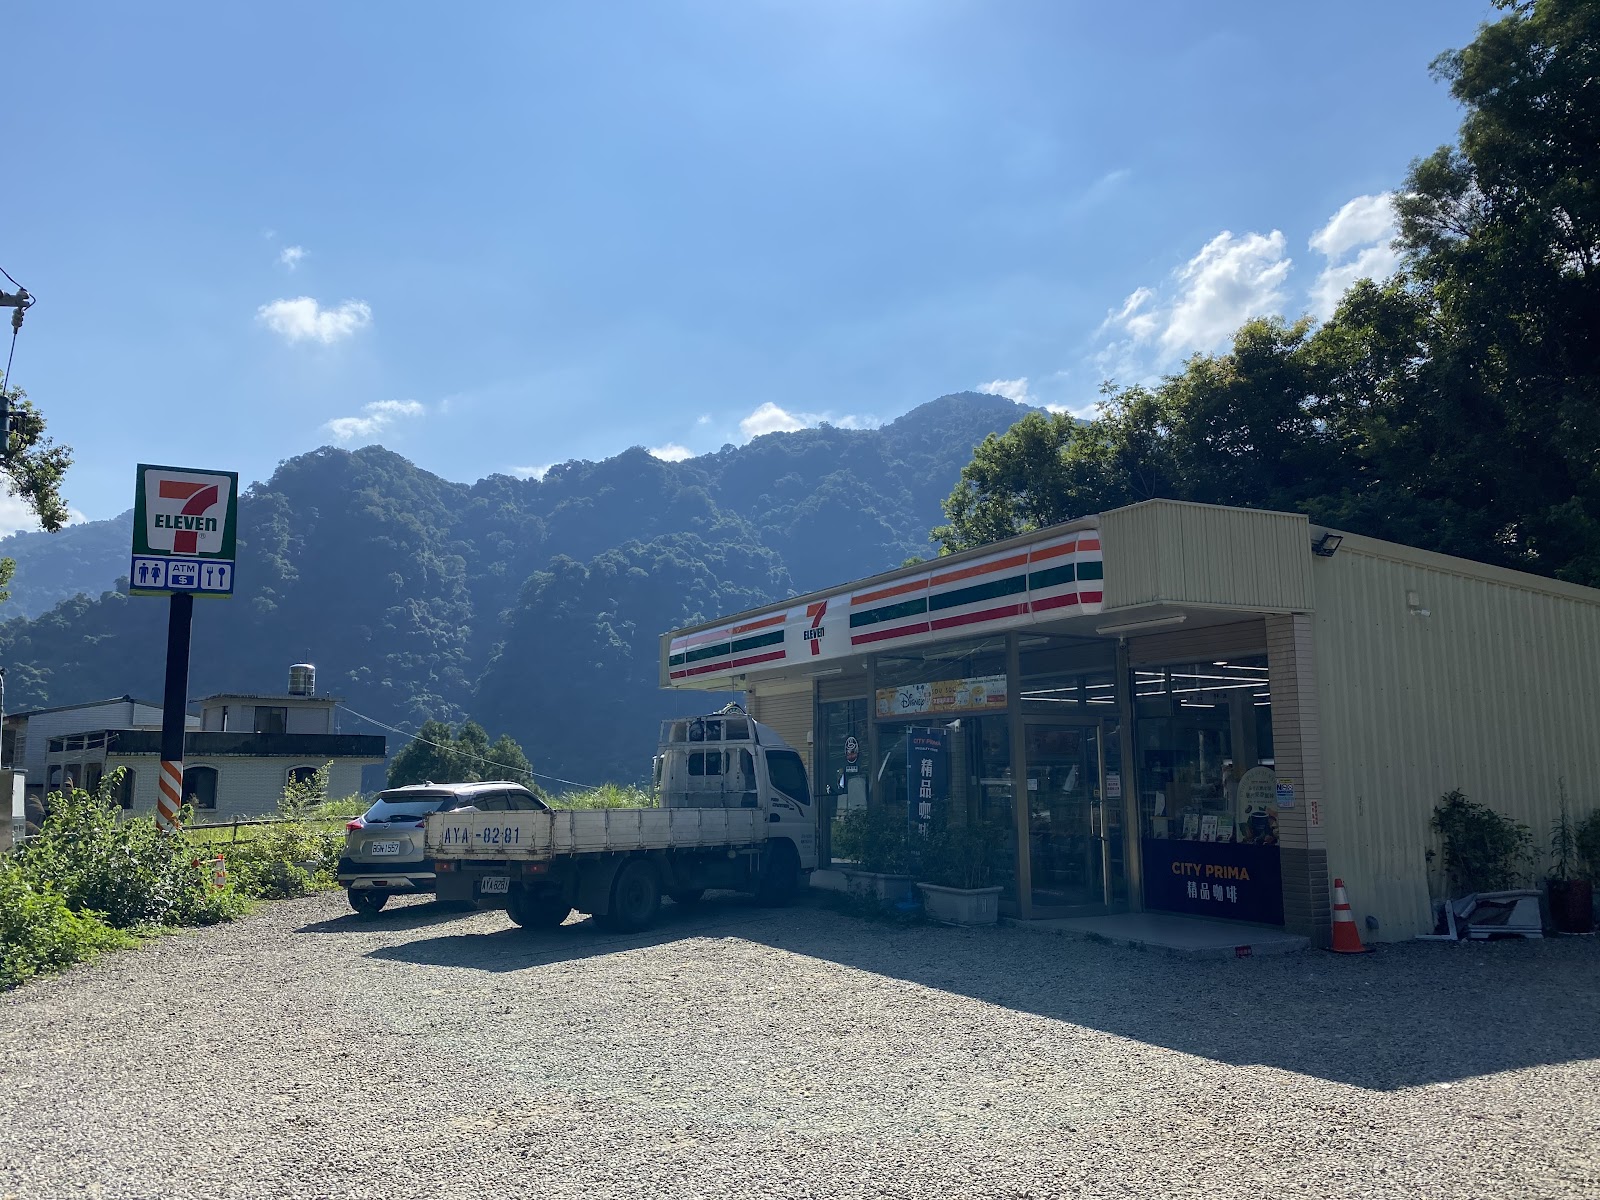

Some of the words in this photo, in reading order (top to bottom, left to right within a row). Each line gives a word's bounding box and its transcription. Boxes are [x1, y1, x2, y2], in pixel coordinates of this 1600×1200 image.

[159, 479, 219, 553] 7
[172, 564, 195, 573] ATM
[805, 600, 828, 656] 7
[1171, 861, 1202, 877] CITY
[1205, 864, 1250, 881] PRIMA
[1187, 880, 1238, 904] 精品咖啡
